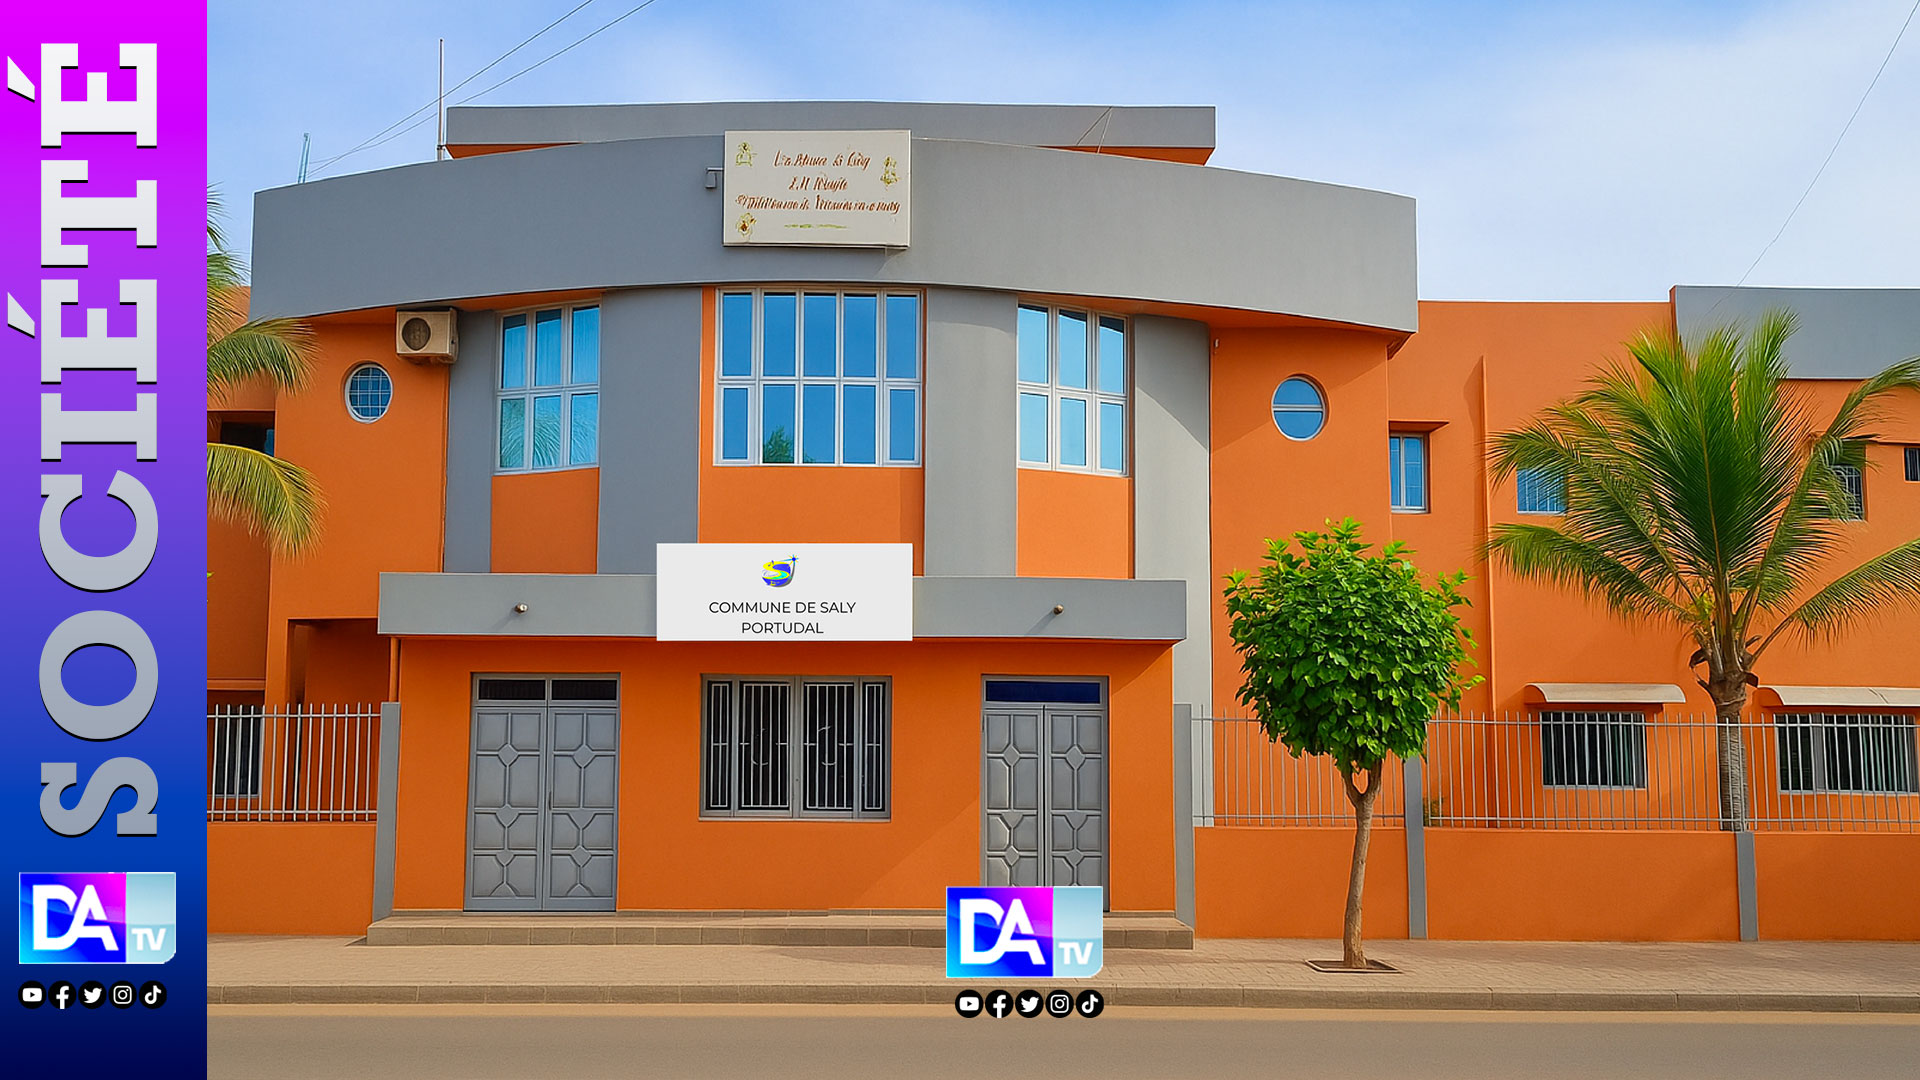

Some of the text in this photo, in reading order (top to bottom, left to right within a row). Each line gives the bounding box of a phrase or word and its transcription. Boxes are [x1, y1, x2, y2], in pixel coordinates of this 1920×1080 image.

[708, 601, 857, 614] COMMUNE DE SALY
[741, 622, 824, 634] PORTUDAL
